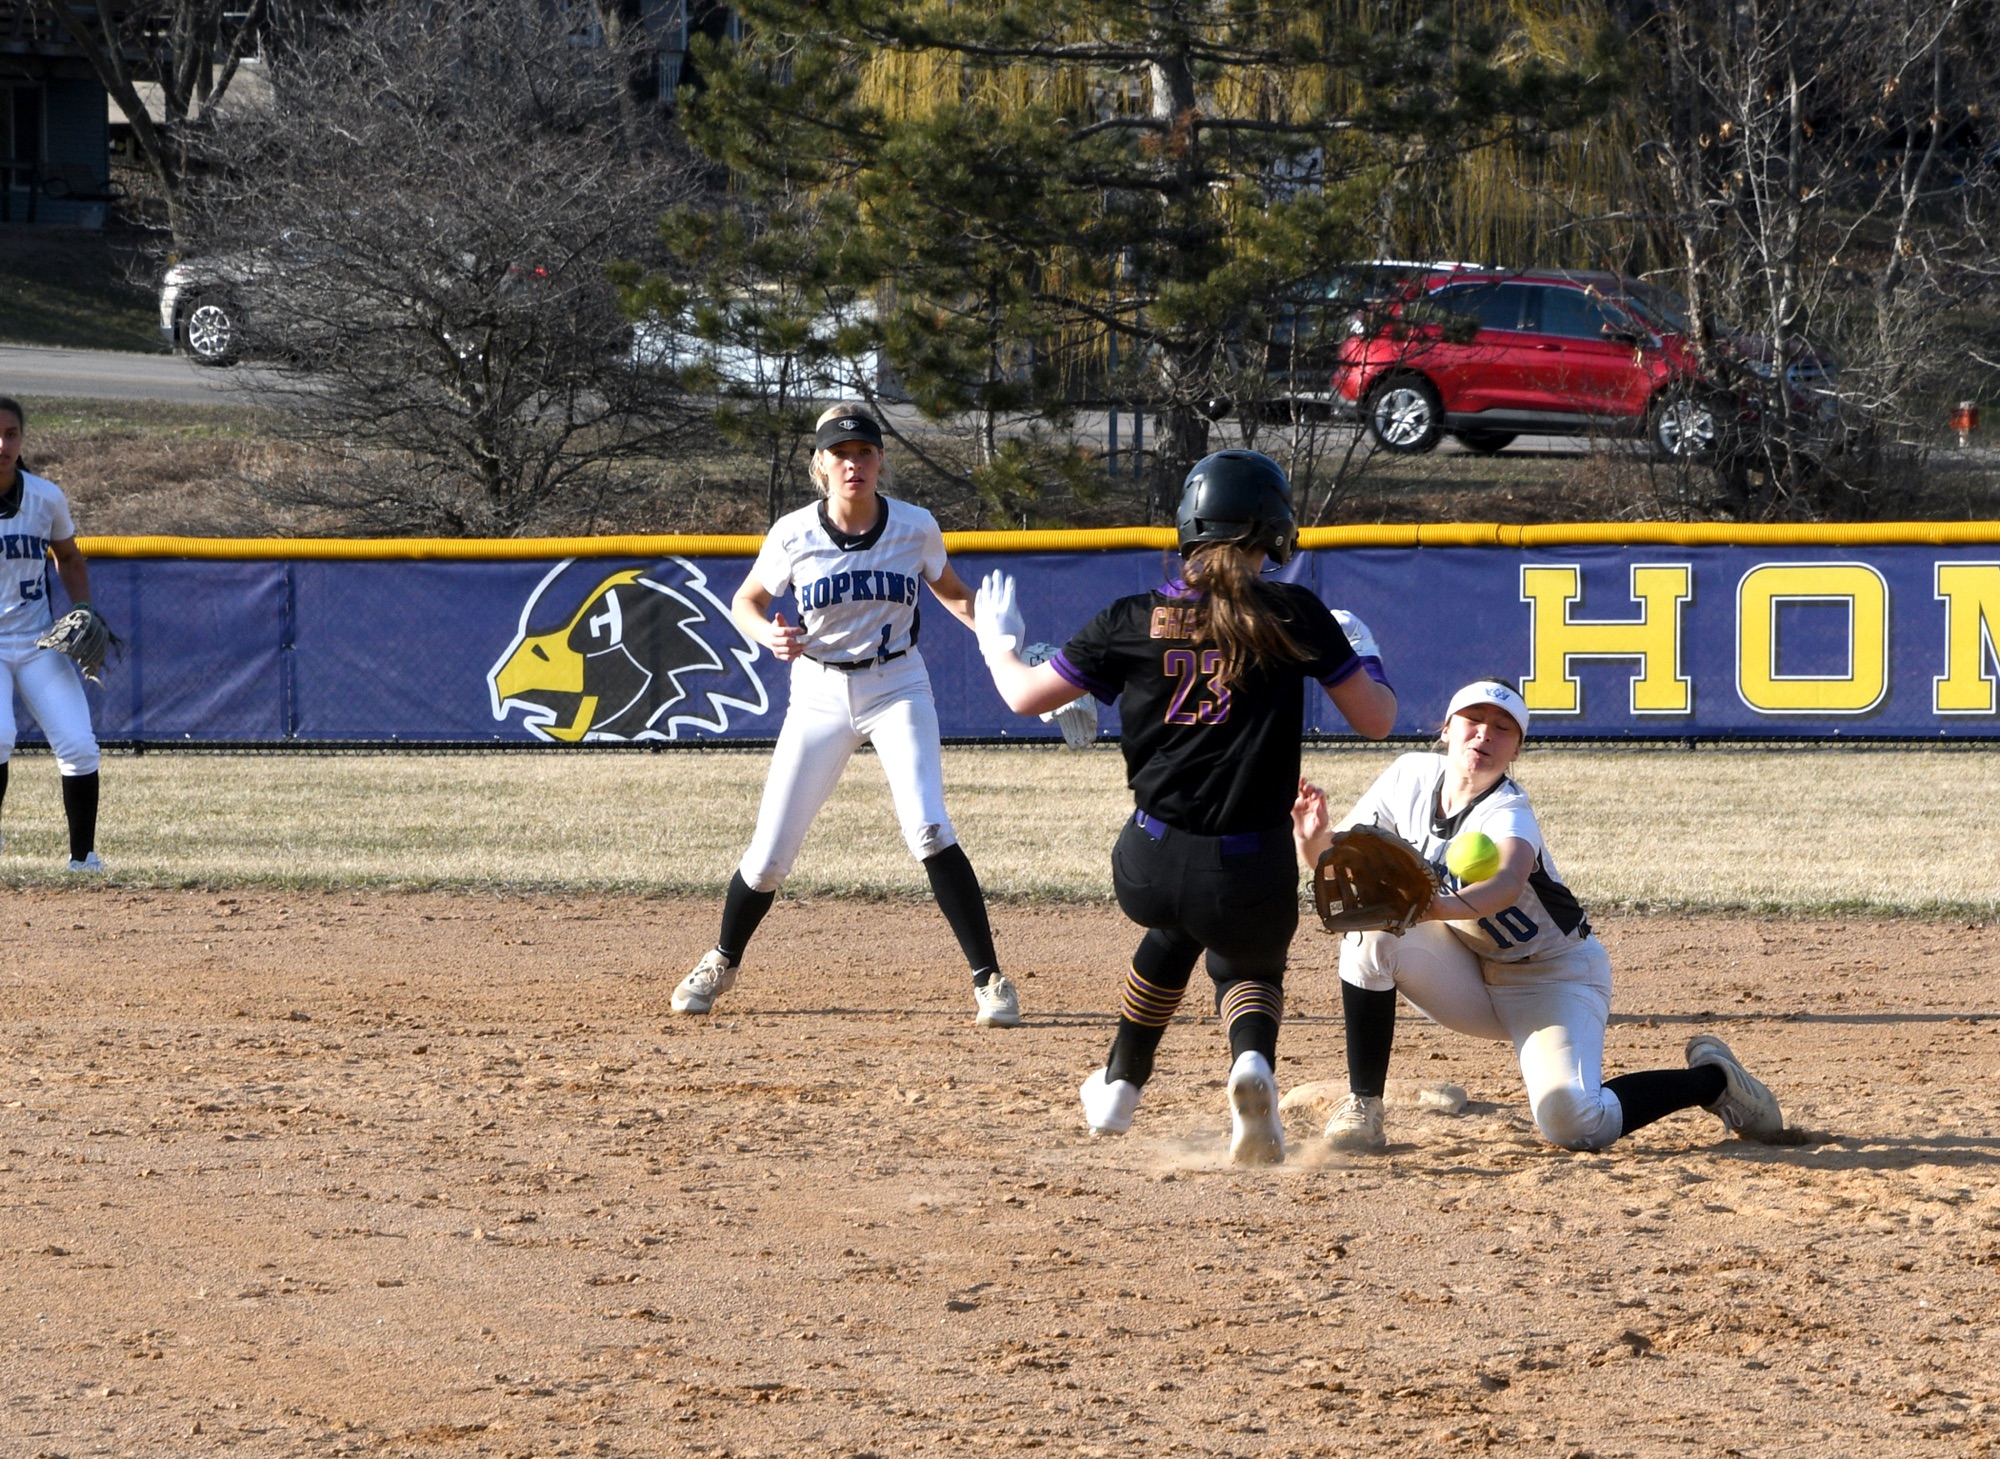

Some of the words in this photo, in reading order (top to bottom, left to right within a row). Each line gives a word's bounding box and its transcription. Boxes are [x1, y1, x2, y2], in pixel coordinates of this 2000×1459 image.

[802, 569, 916, 612] HOPKINS
[877, 623, 892, 657] 1
[1163, 648, 1232, 725] 23
[1478, 905, 1539, 949] 10
